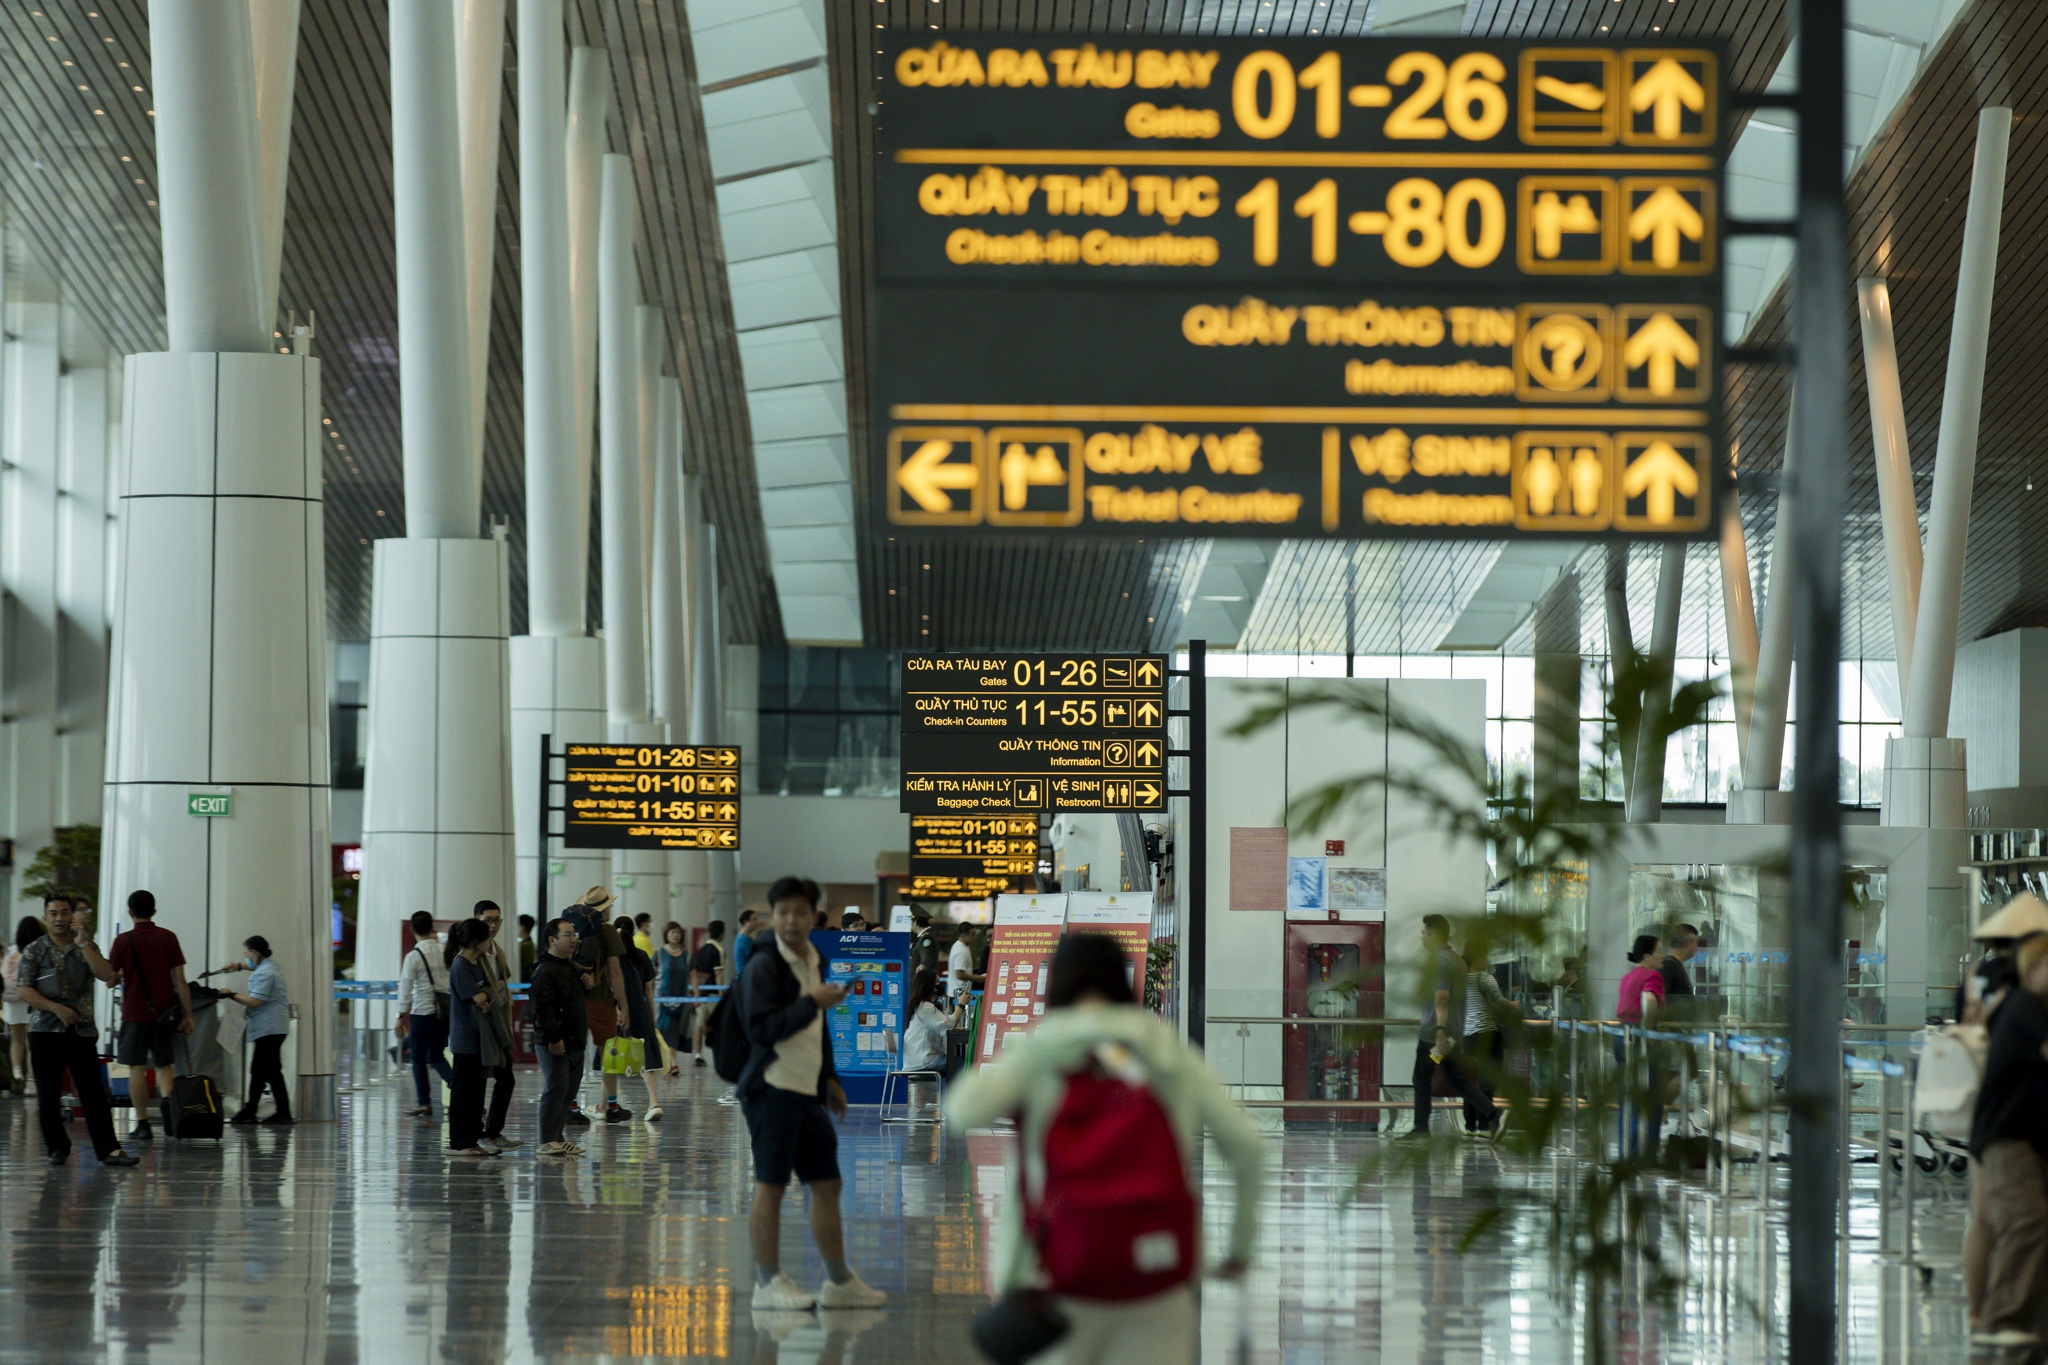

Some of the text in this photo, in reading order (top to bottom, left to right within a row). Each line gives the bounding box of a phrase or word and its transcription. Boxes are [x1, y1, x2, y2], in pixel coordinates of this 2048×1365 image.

[987, 48, 1048, 88] RA
[1049, 42, 1132, 89] TÀU
[1134, 50, 1220, 89] BAY
[1232, 50, 1509, 141] 01-26
[1125, 102, 1221, 138] Gates
[1235, 177, 1507, 268] 11-80
[1081, 229, 1220, 267] Counters
[1300, 299, 1445, 347] THÔNG
[1446, 305, 1515, 347] TIN
[1345, 358, 1515, 396] Information
[1412, 434, 1511, 477] SINH
[907, 657, 1007, 671] CỬA RA TÀU BAY
[980, 677, 1008, 687] Gates
[1013, 660, 1098, 687] 01-26
[915, 696, 1008, 713] QUẦY THỦ TỤC
[1015, 699, 1098, 727] 11-55
[924, 716, 1008, 727] Check-in Counters
[999, 737, 1101, 752] QUẦY THÔNG TIN
[637, 748, 696, 767] 01-26
[1050, 757, 1101, 767] Information
[637, 774, 695, 793] 01-10
[906, 777, 1012, 791] KIỂM TRA HÀNH LÝ
[1052, 778, 1100, 794] VỆ SINH
[198, 797, 227, 812] EXIT
[639, 801, 696, 820] 11-55
[937, 798, 1012, 808] Baggage Check
[1056, 798, 1101, 807] Restroom
[963, 820, 1007, 835] 01-10
[964, 840, 1007, 855] 11-55
